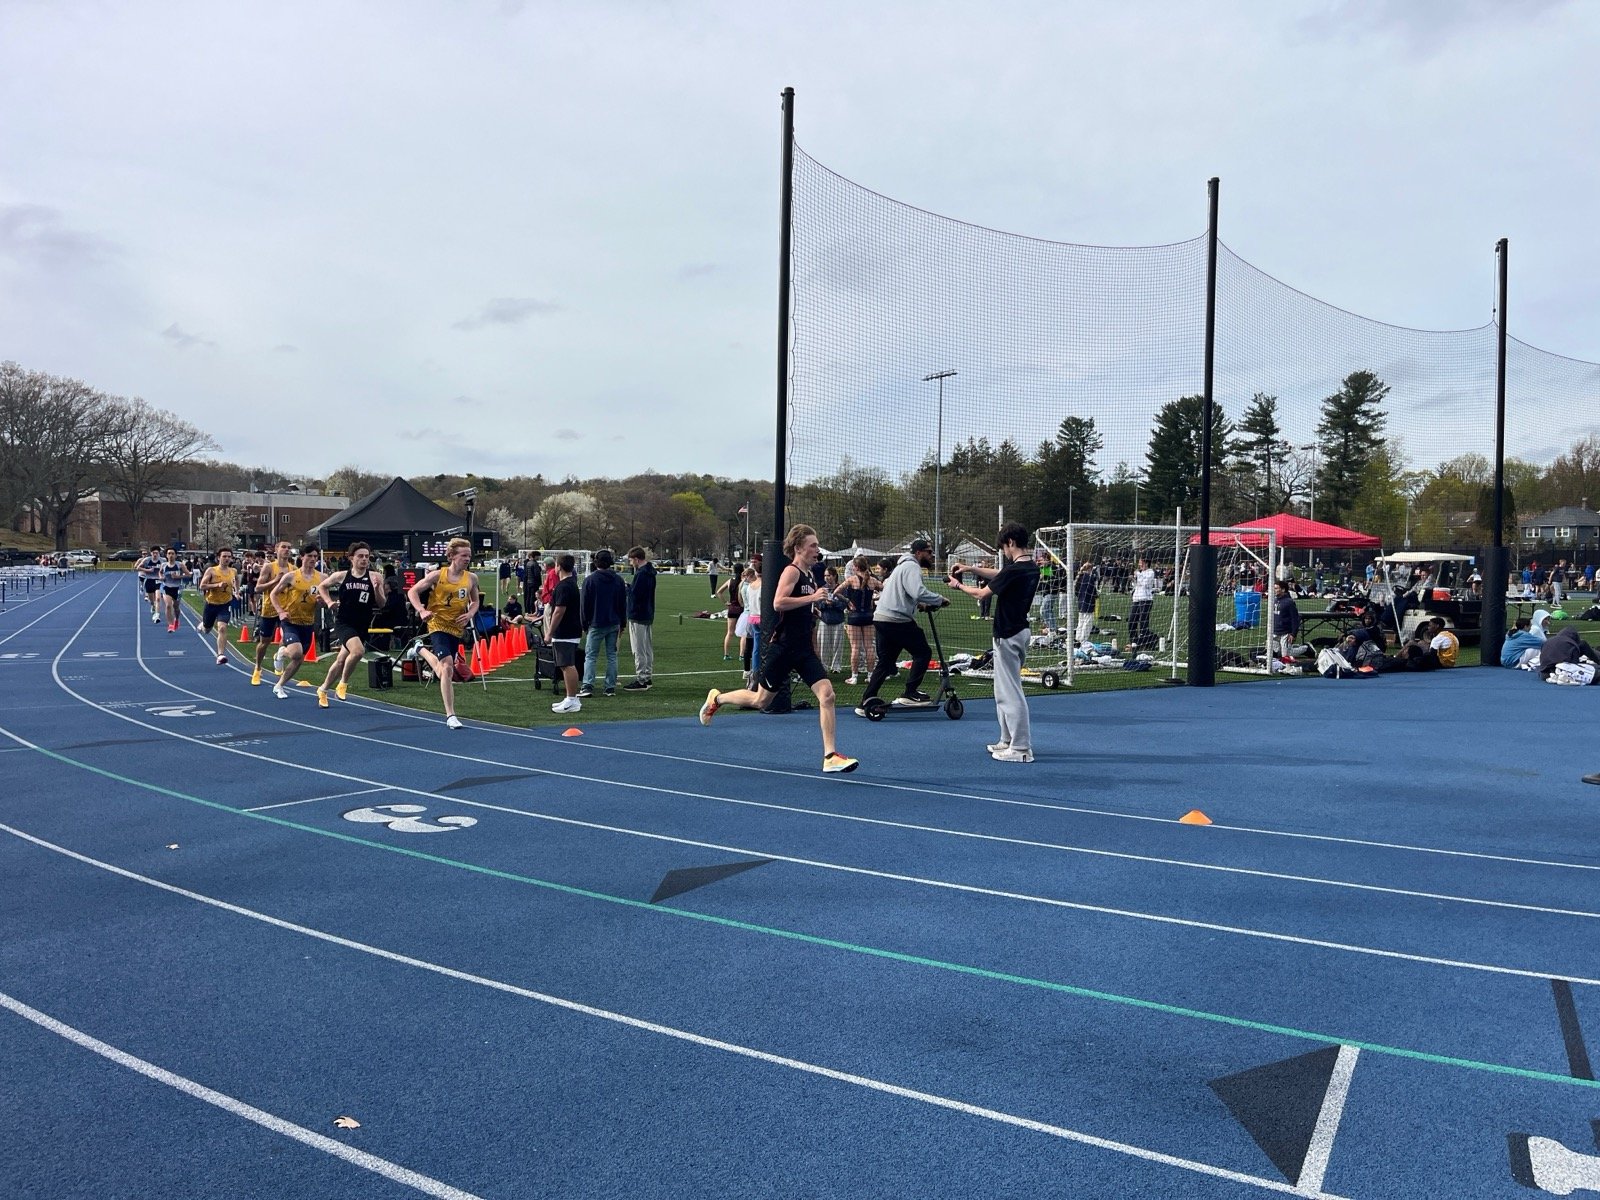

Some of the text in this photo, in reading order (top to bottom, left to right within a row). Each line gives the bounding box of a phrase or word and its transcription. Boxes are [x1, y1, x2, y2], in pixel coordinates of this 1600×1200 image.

[311, 586, 317, 595] 2
[345, 582, 370, 591] READING
[360, 592, 369, 603] 4
[460, 588, 467, 599] 3
[343, 804, 478, 833] 3
